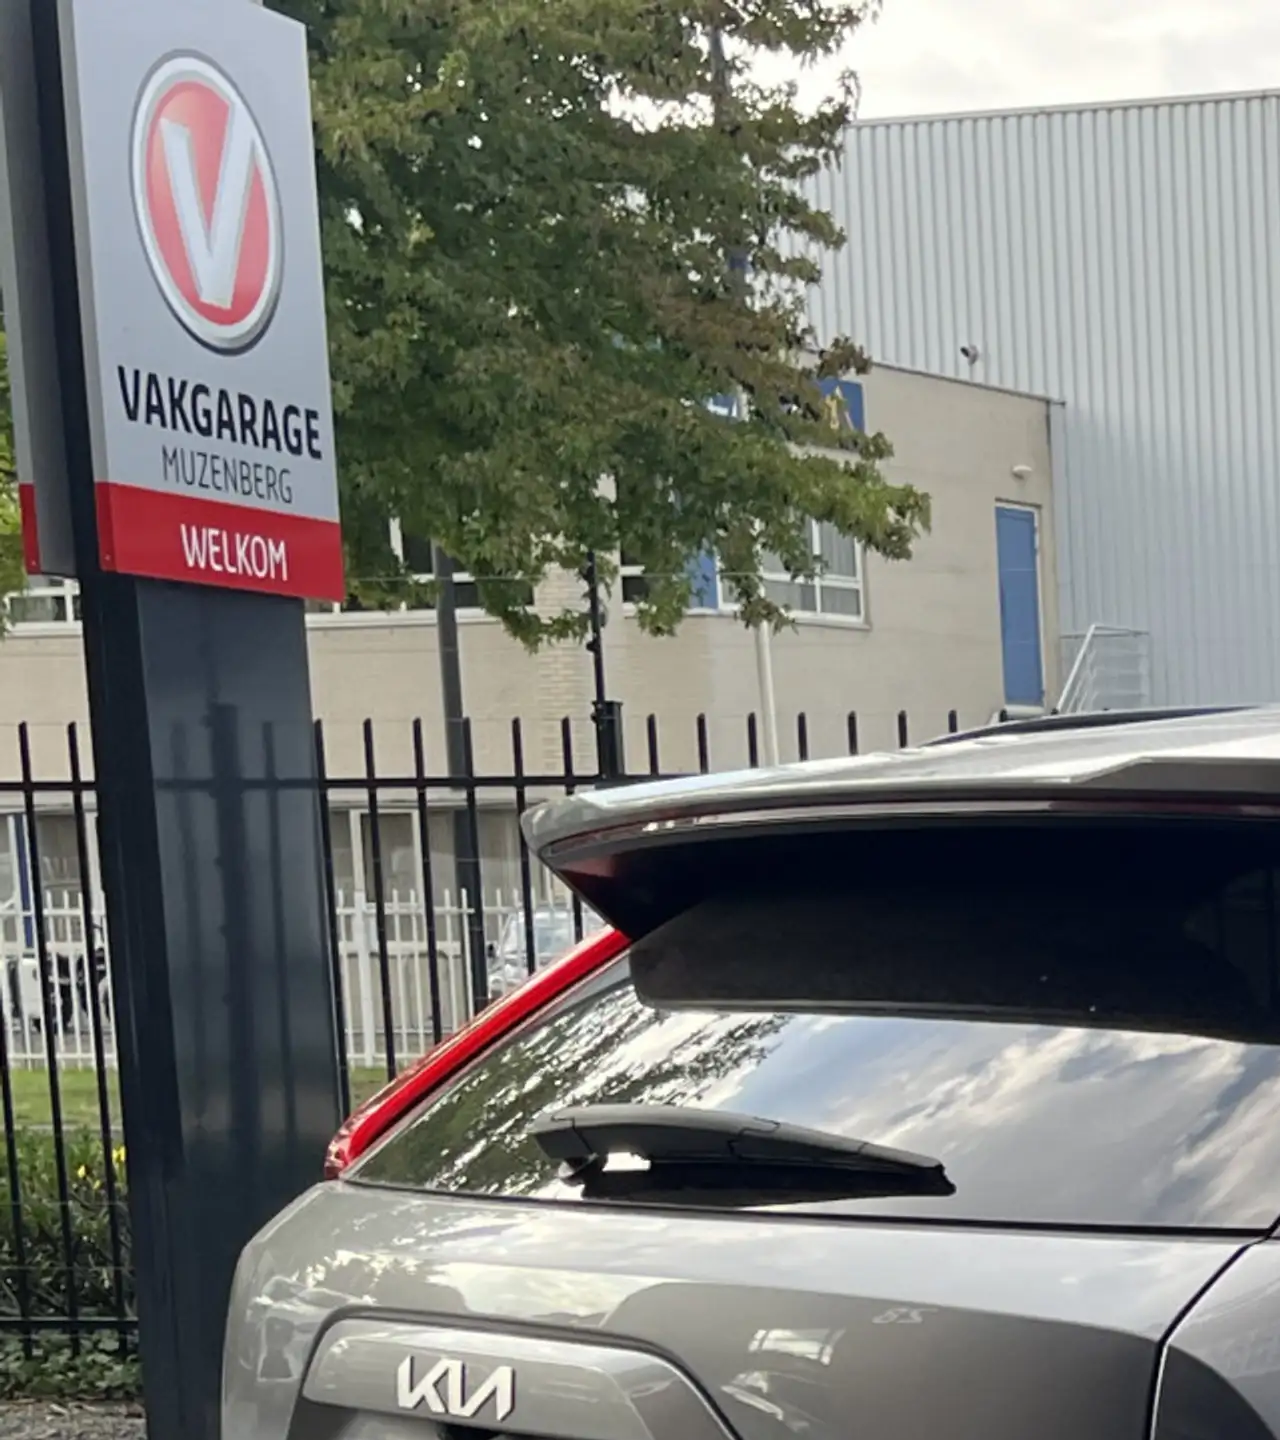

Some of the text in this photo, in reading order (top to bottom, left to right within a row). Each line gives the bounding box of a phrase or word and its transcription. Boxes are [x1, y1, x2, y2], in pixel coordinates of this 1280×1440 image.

[117, 365, 323, 460] VAKGARAGE
[161, 445, 293, 504] MUZENBERG
[180, 523, 288, 582] WELKOM
[397, 1353, 515, 1422] KIA
